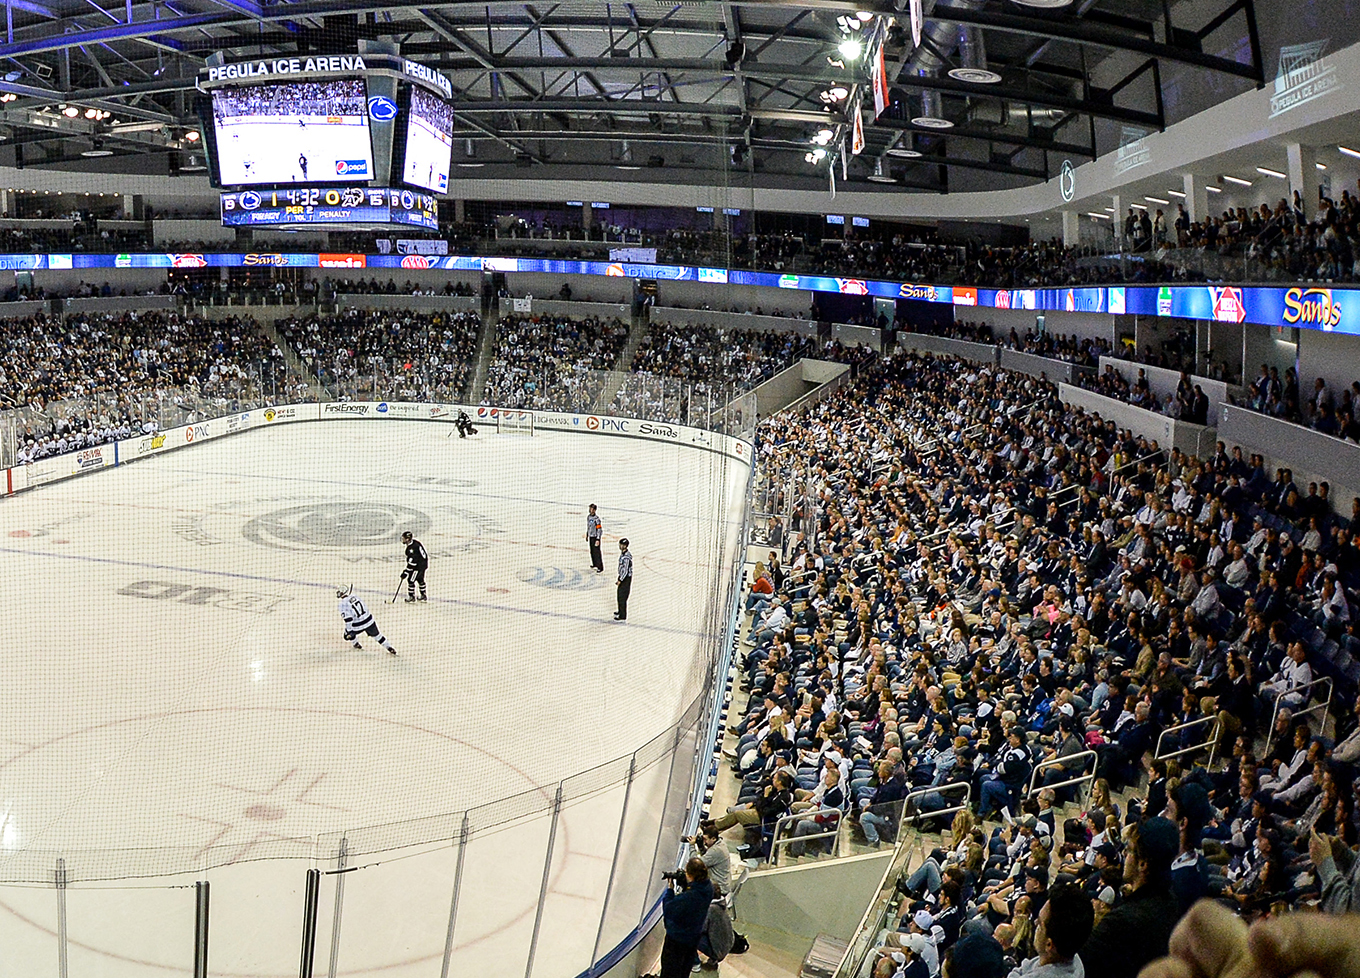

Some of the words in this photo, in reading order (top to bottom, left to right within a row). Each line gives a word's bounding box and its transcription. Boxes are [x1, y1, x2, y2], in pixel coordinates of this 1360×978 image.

[209, 62, 269, 81] PEGULA
[271, 60, 301, 74] ICE
[305, 56, 367, 73] ARENA
[405, 60, 437, 83] PEGULA
[287, 188, 320, 205] 4:32
[325, 190, 340, 205] 0
[286, 206, 304, 214] PER
[306, 206, 313, 214] 2
[319, 210, 351, 219] PENALTY
[242, 252, 289, 266] Sands
[899, 283, 939, 301] Sands
[1282, 288, 1341, 332] Sands
[325, 403, 370, 414] FirstEnergy
[195, 423, 211, 439] PNC
[602, 419, 629, 432] PNC
[639, 424, 678, 438] Sands
[352, 600, 366, 619] 17
